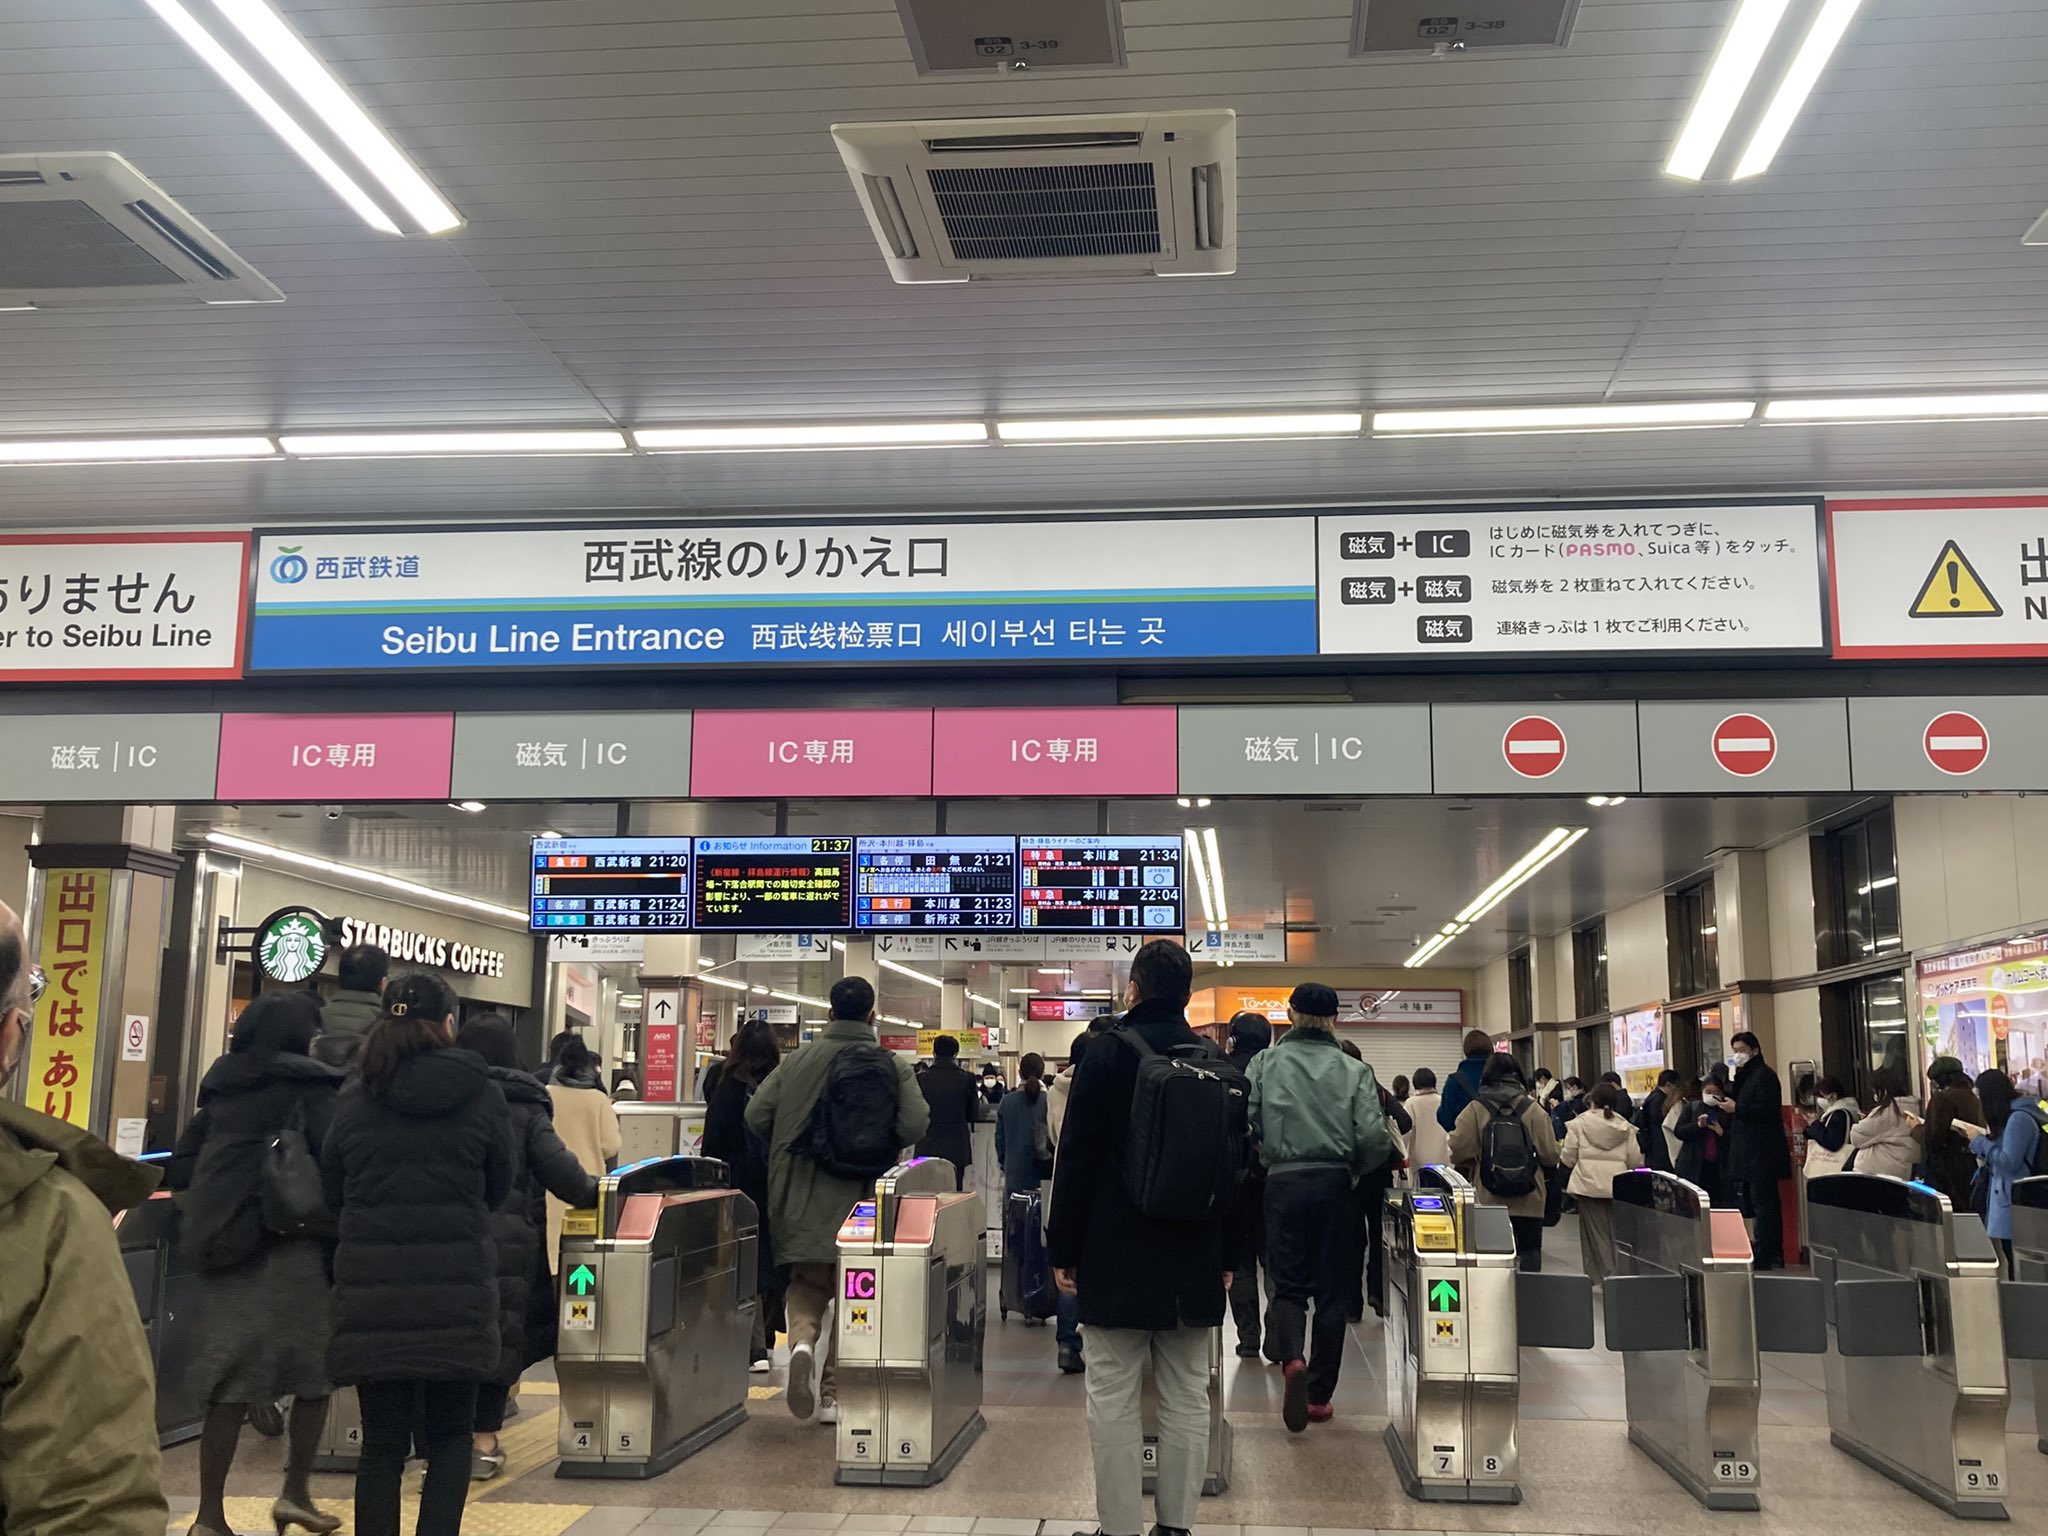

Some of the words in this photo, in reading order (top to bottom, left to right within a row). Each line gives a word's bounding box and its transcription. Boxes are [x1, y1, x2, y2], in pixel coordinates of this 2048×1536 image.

[1426, 26, 1449, 35] 02
[1465, 20, 1505, 30] 3-38
[984, 46, 1005, 54] 02
[1020, 40, 1058, 49] 3-39
[1489, 523, 1721, 541] はじめに磁気券を入れてつぎに、
[1348, 536, 1386, 554] 磁気
[1432, 535, 1455, 553] IC
[584, 535, 948, 583] 西武線のりかえ口
[315, 555, 421, 580] 西武鉄道
[0, 572, 195, 615] りません
[1349, 581, 1386, 599] 磁気
[1424, 580, 1462, 598] 磁気
[941, 618, 1055, 648] 세이부선
[1069, 618, 1126, 646] 타는
[1137, 616, 1166, 646] 곳
[1425, 620, 1463, 638] 磁気
[26, 625, 53, 648] to
[63, 624, 142, 648] Seibu
[152, 623, 212, 647] Line
[382, 626, 477, 655] Seibu
[489, 625, 560, 653] Line
[571, 622, 725, 652] Entrance
[751, 621, 921, 650] 西武线检票口
[292, 743, 377, 768] IC専用
[516, 742, 567, 767] 磁気
[597, 742, 627, 766] IC
[768, 739, 855, 764] IC専用
[1010, 737, 1098, 763] IC専用
[1244, 736, 1299, 763] 磁気
[1331, 737, 1363, 761] IC
[51, 745, 100, 770] 磁気
[128, 745, 158, 768] IC
[535, 841, 568, 849] 西武新宿
[714, 842, 747, 850] お知らせ
[750, 841, 808, 850] Information
[813, 840, 850, 851] 21:37
[879, 856, 904, 865] 各停
[925, 855, 961, 866] 田無
[974, 855, 1011, 866] 21:21
[1030, 850, 1055, 860] 特急
[1083, 849, 1119, 861] 本川越
[1140, 849, 1178, 861] 21:34
[555, 856, 580, 867] 急行
[594, 856, 642, 867] 西武新宿
[649, 856, 687, 867] 21:20
[1030, 890, 1055, 900] 特急
[1083, 889, 1119, 901] 本川越
[1140, 889, 1179, 901] 22:04
[555, 899, 579, 910] 各停
[593, 898, 641, 910] 西武新宿
[648, 898, 686, 910] 21:24
[705, 904, 743, 913] ています。
[879, 899, 904, 909] 急行
[924, 898, 961, 910] 本川越
[974, 898, 1012, 909] 21:23
[593, 914, 641, 925] 西武新宿
[648, 914, 686, 925] 21:27
[879, 914, 904, 924] 各停
[924, 914, 960, 925] 新所沢
[974, 913, 1012, 925] 21:27
[986, 936, 1039, 944] JR線きっぷうりば
[1051, 936, 1101, 944] JR線のりかえ口
[340, 916, 447, 967] STARBUCKS
[450, 941, 506, 978] COFFEE
[846, 1270, 875, 1298] IC
[348, 1429, 359, 1441] 4
[577, 1435, 587, 1447] 4
[620, 1435, 630, 1448] 5
[857, 1442, 866, 1454] 5
[901, 1442, 911, 1454] 6
[1143, 1449, 1153, 1461] 6
[1439, 1457, 1449, 1469] 7
[1486, 1458, 1496, 1470] 8
[1720, 1464, 1731, 1476] 8
[1738, 1464, 1749, 1476] 9
[1967, 1473, 1978, 1485] 9
[1986, 1473, 1999, 1486] 10
